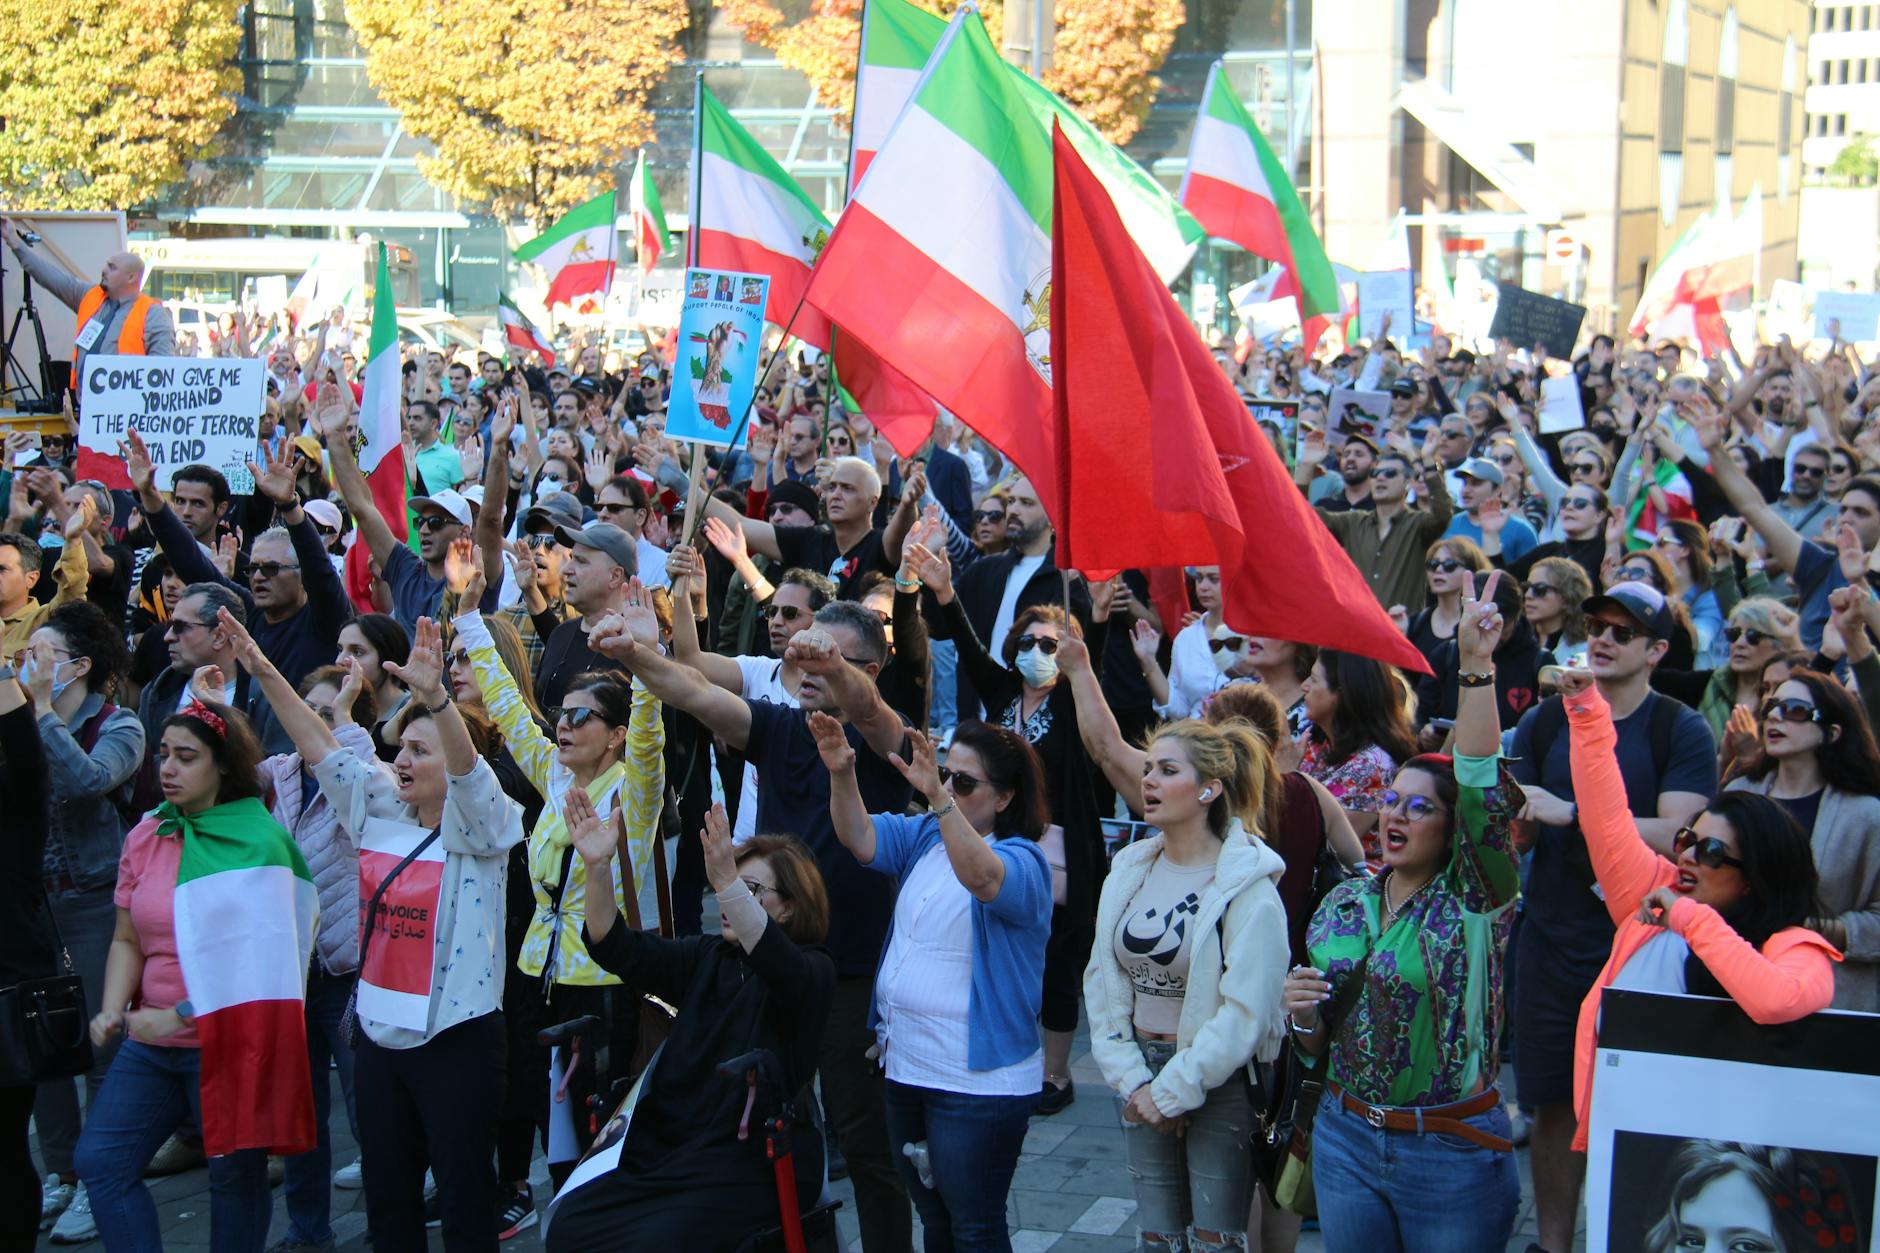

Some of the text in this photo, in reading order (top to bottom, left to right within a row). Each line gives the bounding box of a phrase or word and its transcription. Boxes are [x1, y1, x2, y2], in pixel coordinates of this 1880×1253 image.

[89, 367, 242, 394] COME ON GIVE ME
[92, 414, 124, 434] THE
[201, 414, 256, 438] TERROR
[170, 438, 206, 463] END
[389, 904, 428, 921] VOICE
[391, 920, 426, 939] صدای
